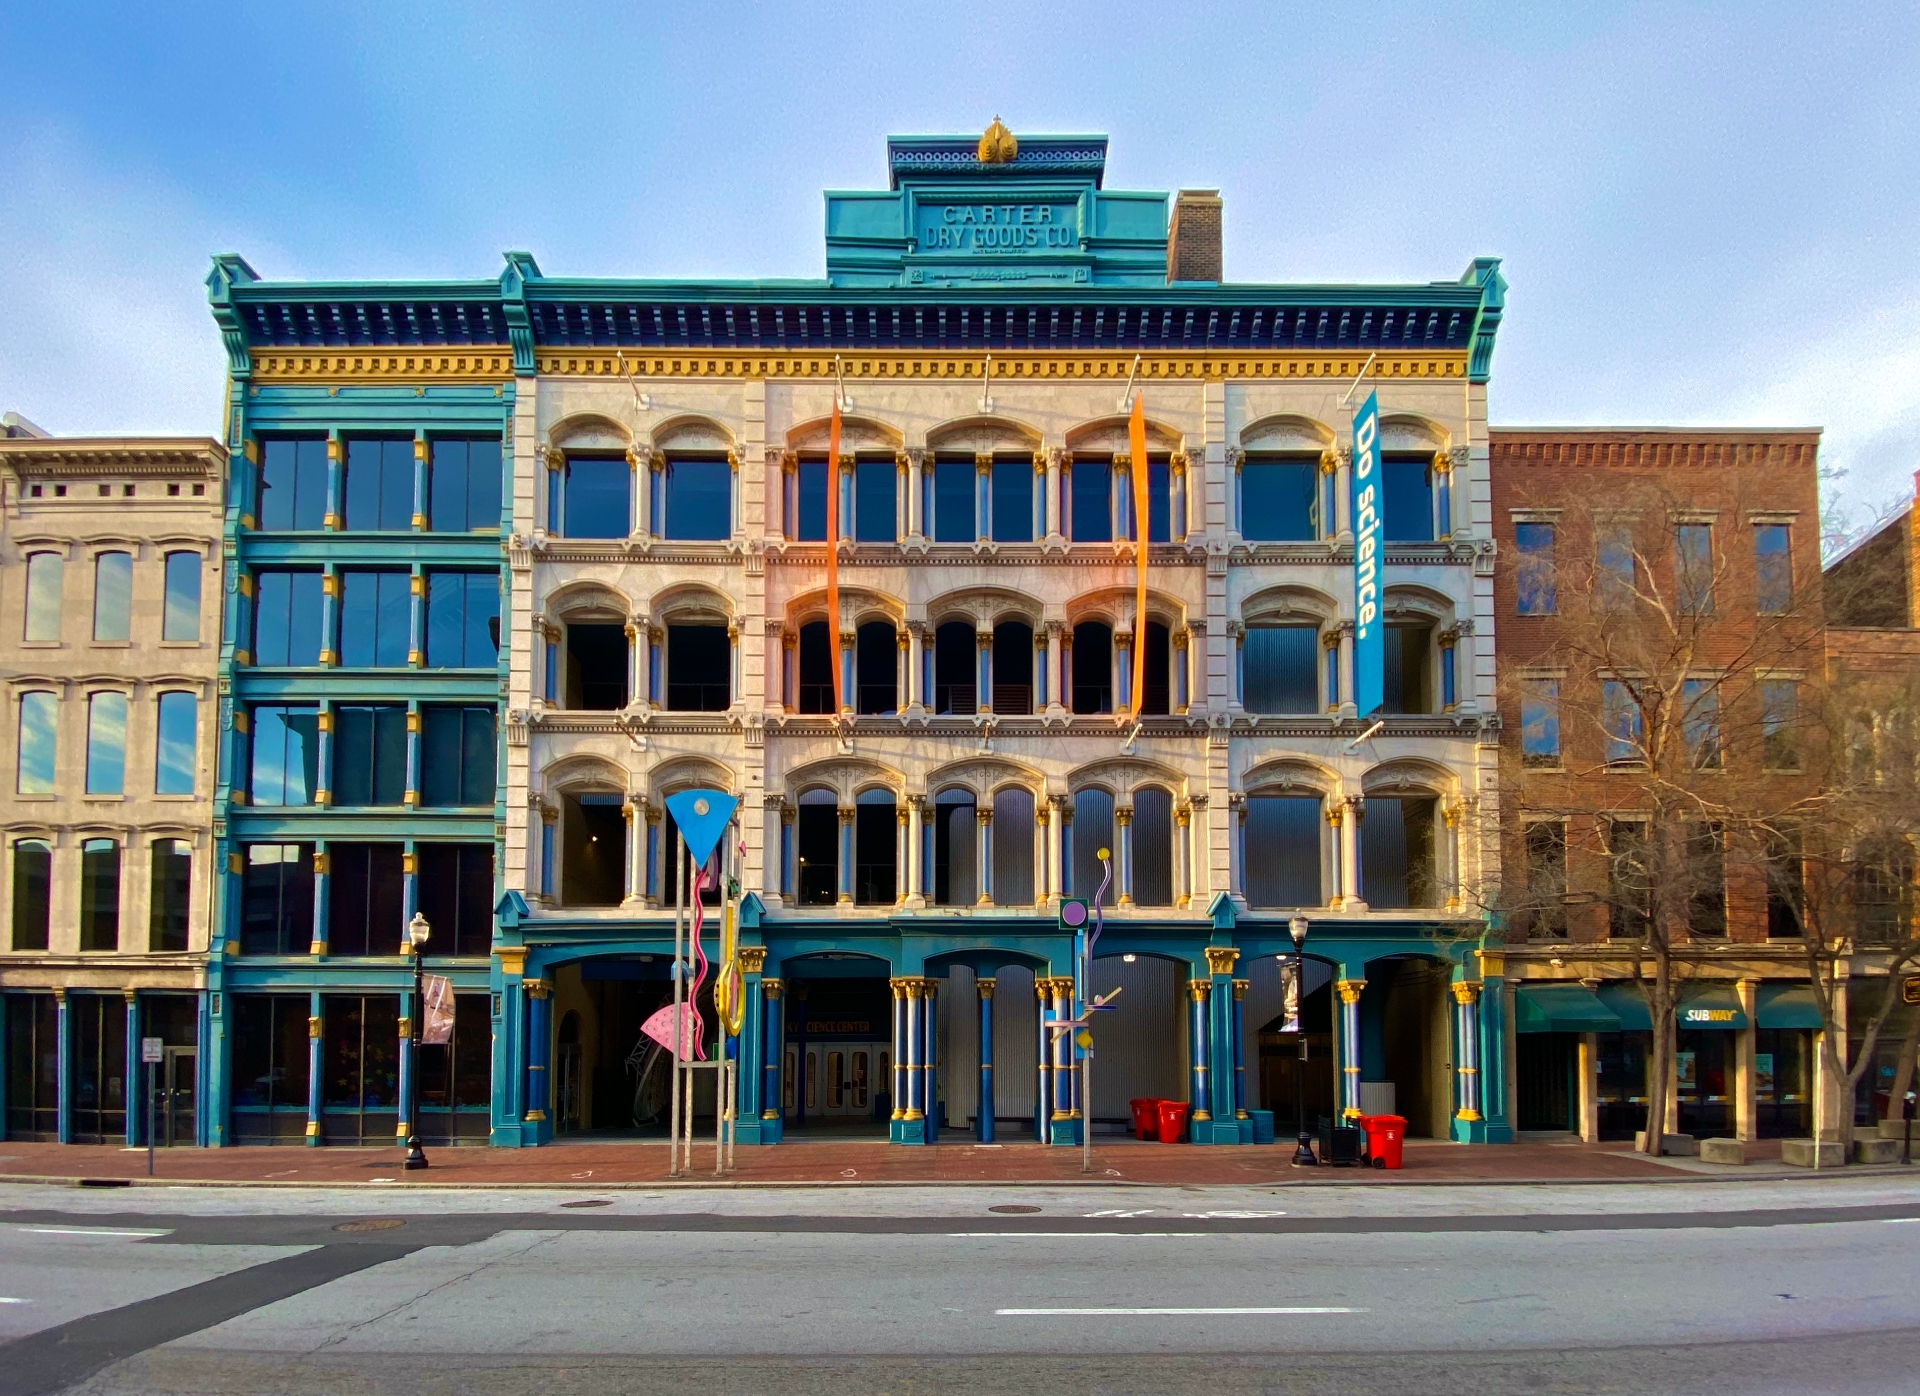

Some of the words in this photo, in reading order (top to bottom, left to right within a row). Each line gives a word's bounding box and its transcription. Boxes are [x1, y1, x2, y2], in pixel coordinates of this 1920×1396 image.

[943, 205, 1053, 225] CARTER
[925, 227, 966, 248] DRY
[972, 227, 1038, 248] GOODS
[1356, 411, 1376, 479] Do
[1357, 483, 1381, 640] science.
[1684, 1009, 1739, 1022] SUBWAY
[806, 1021, 836, 1033] CIENCE
[837, 1021, 870, 1033] CENTER
